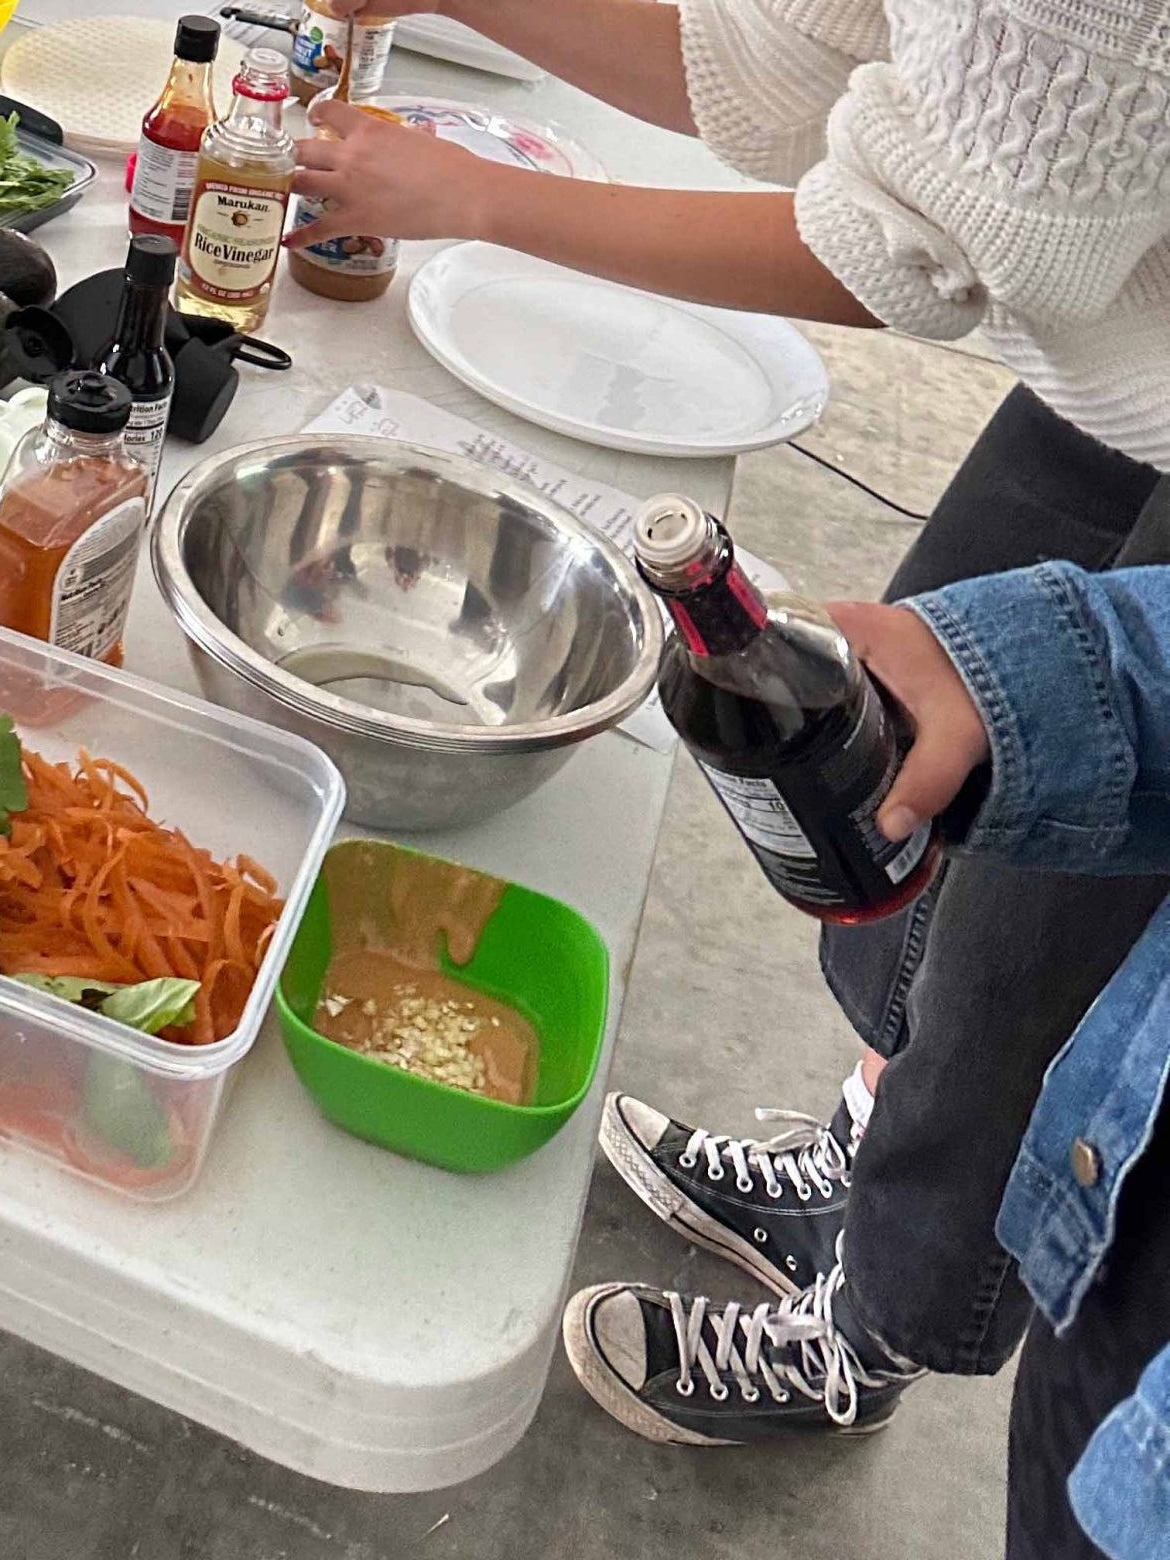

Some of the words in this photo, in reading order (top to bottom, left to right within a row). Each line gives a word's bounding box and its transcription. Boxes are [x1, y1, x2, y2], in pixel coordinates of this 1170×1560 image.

[217, 195, 269, 212] Marukan
[194, 232, 222, 257] Rice
[222, 244, 275, 264] Vinegar
